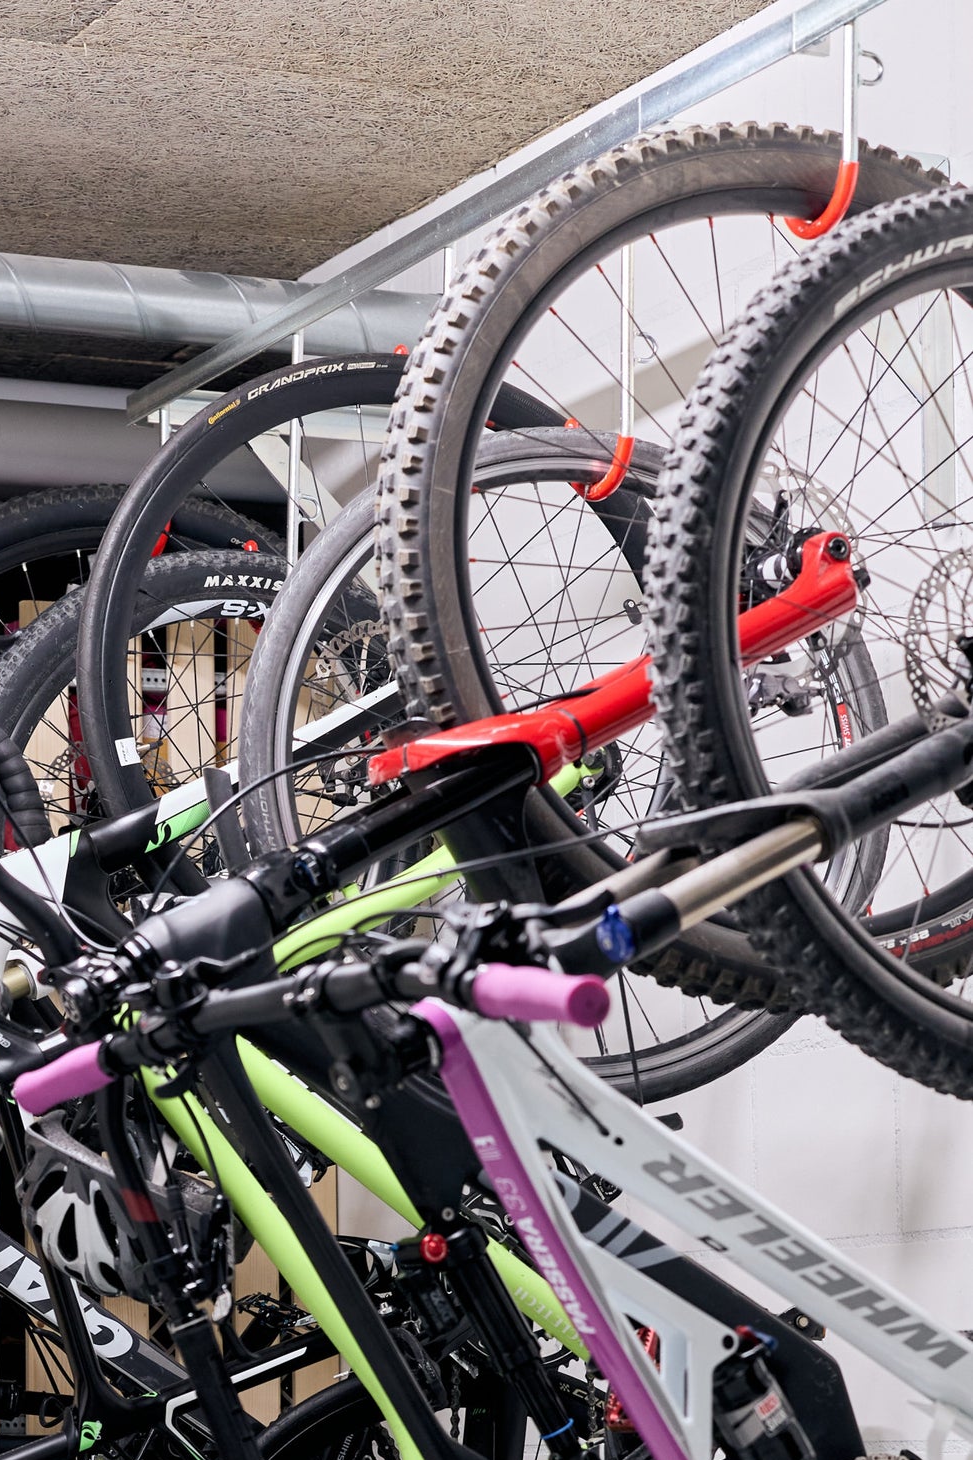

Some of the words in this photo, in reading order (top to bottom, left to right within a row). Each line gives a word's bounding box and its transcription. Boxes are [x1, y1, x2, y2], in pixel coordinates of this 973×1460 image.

[204, 575, 284, 592] MAXXIS
[840, 714, 851, 736] SWISS
[494, 1177, 527, 1213] 33
[517, 1216, 597, 1335] PASSERA
[642, 1153, 970, 1370] WHEELER
